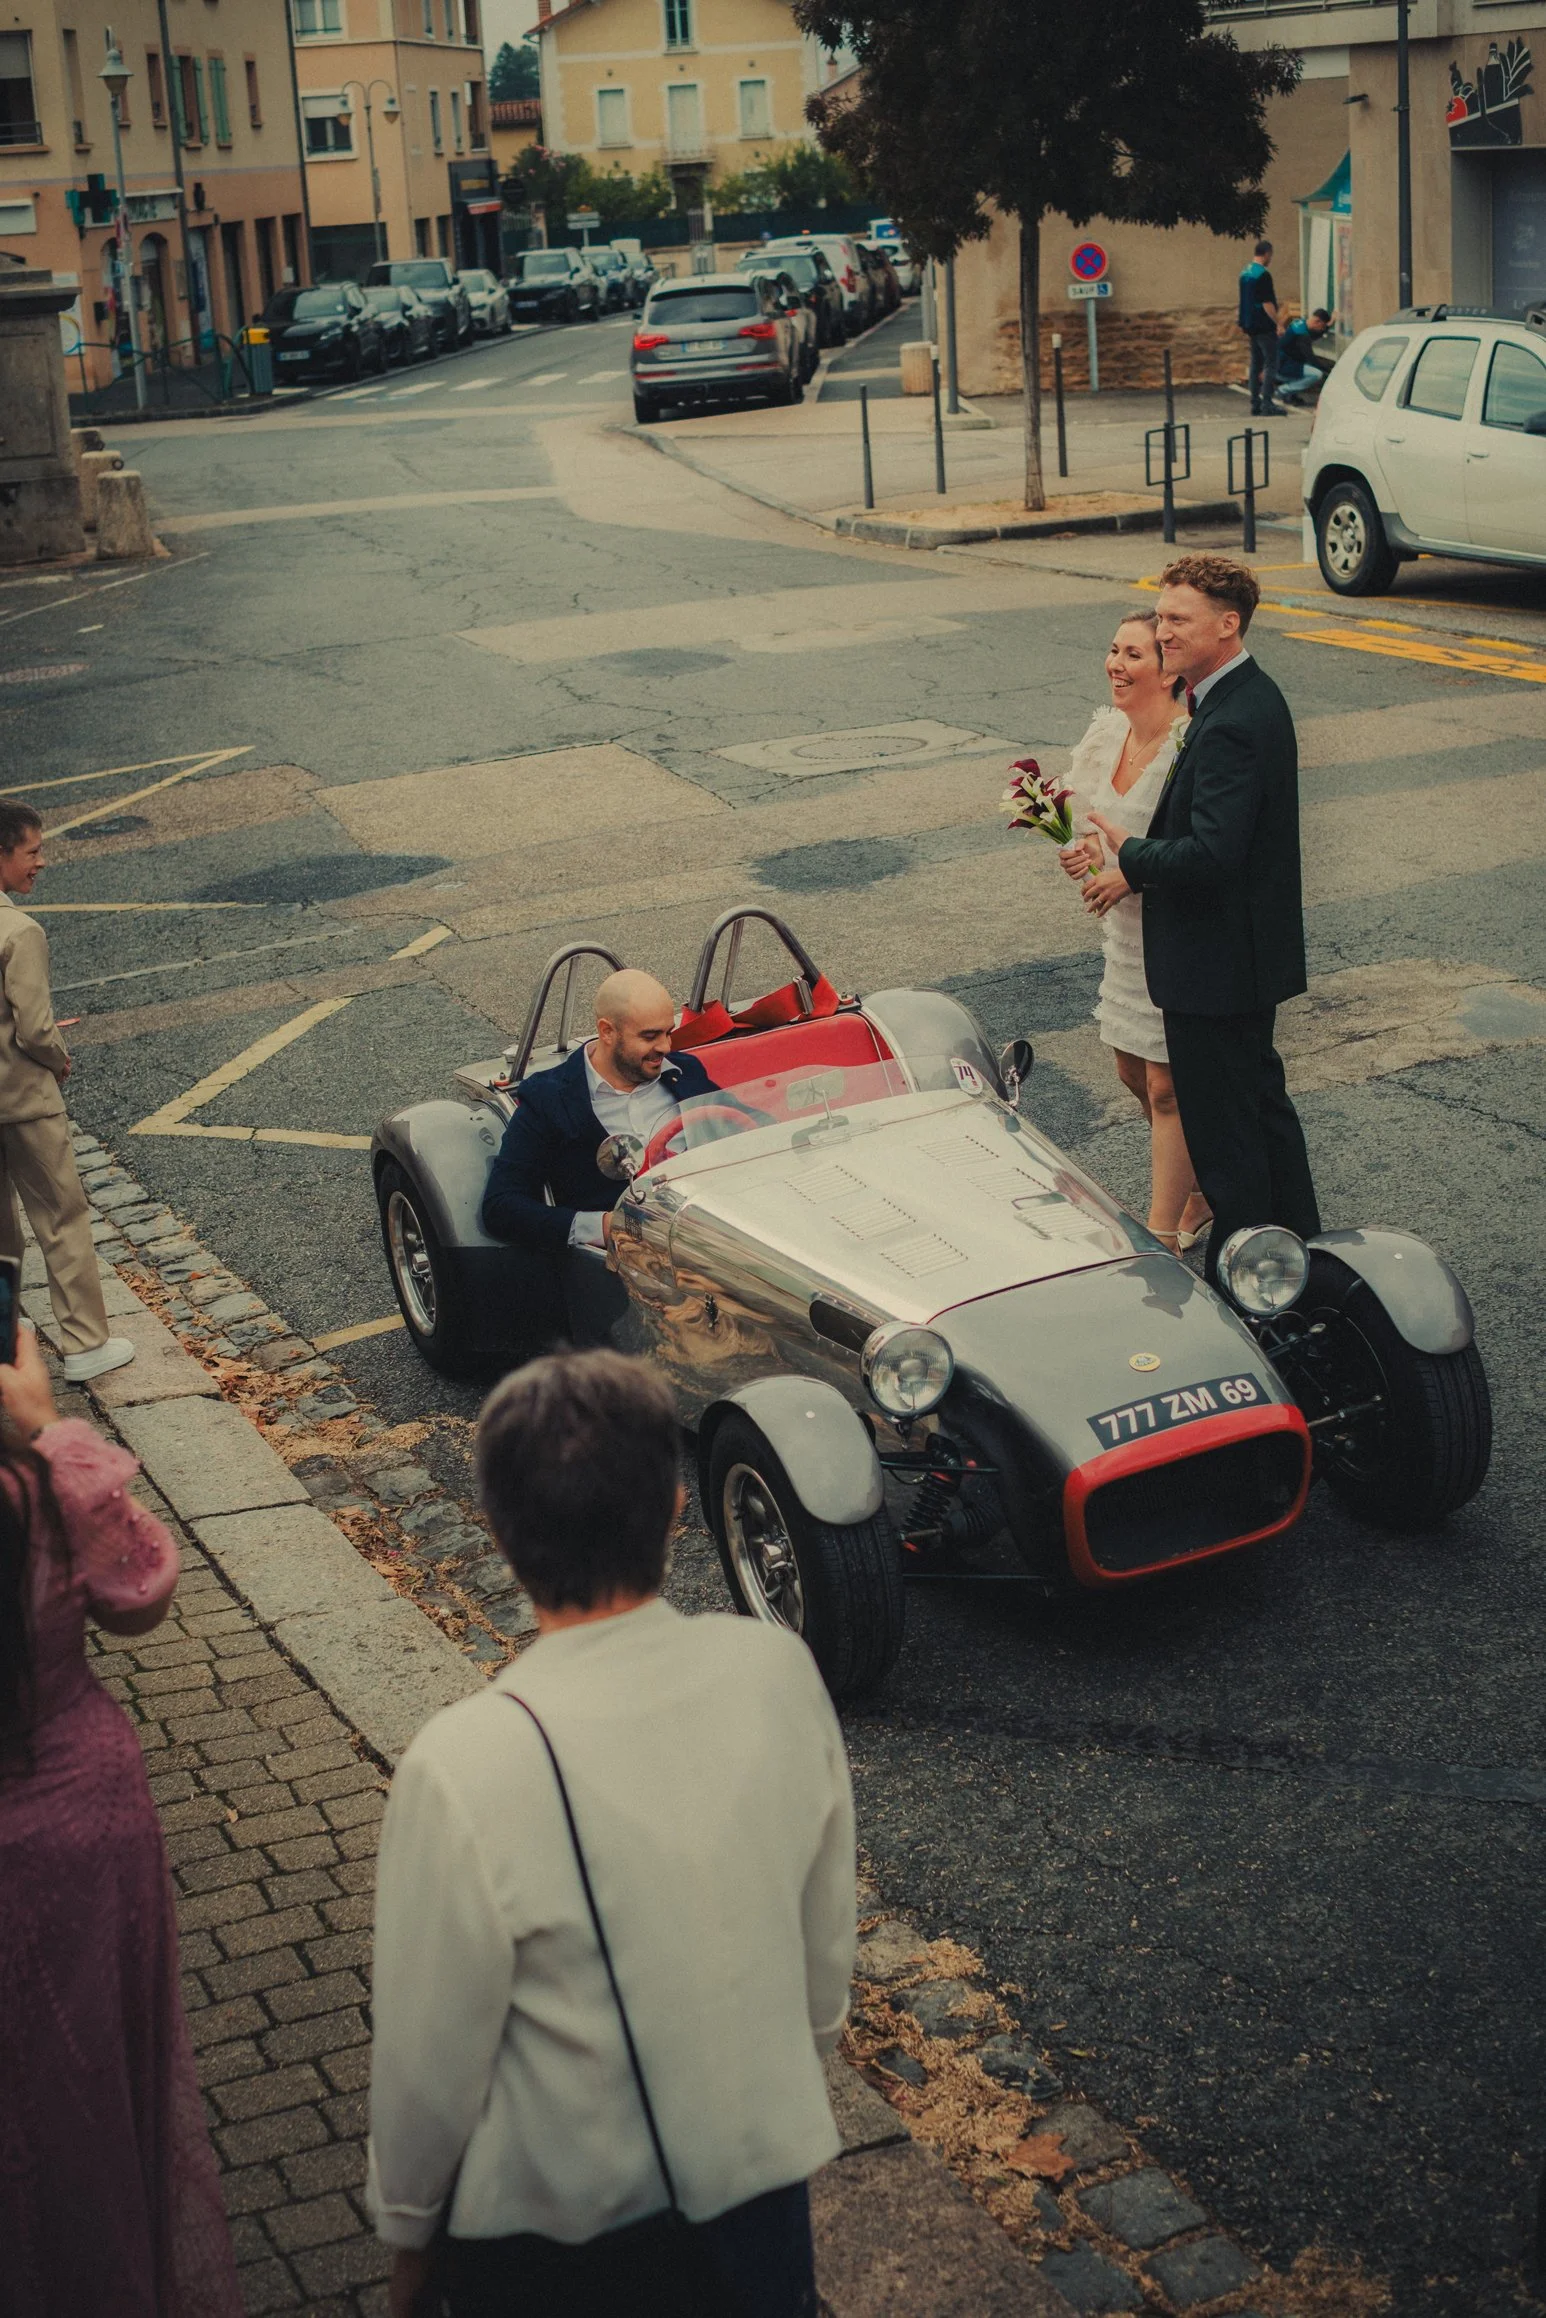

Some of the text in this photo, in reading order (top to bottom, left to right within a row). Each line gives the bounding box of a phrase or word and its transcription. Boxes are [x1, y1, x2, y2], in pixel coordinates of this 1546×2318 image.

[953, 1065, 975, 1080] 74
[1098, 1378, 1258, 1441] 777 ZM 69
